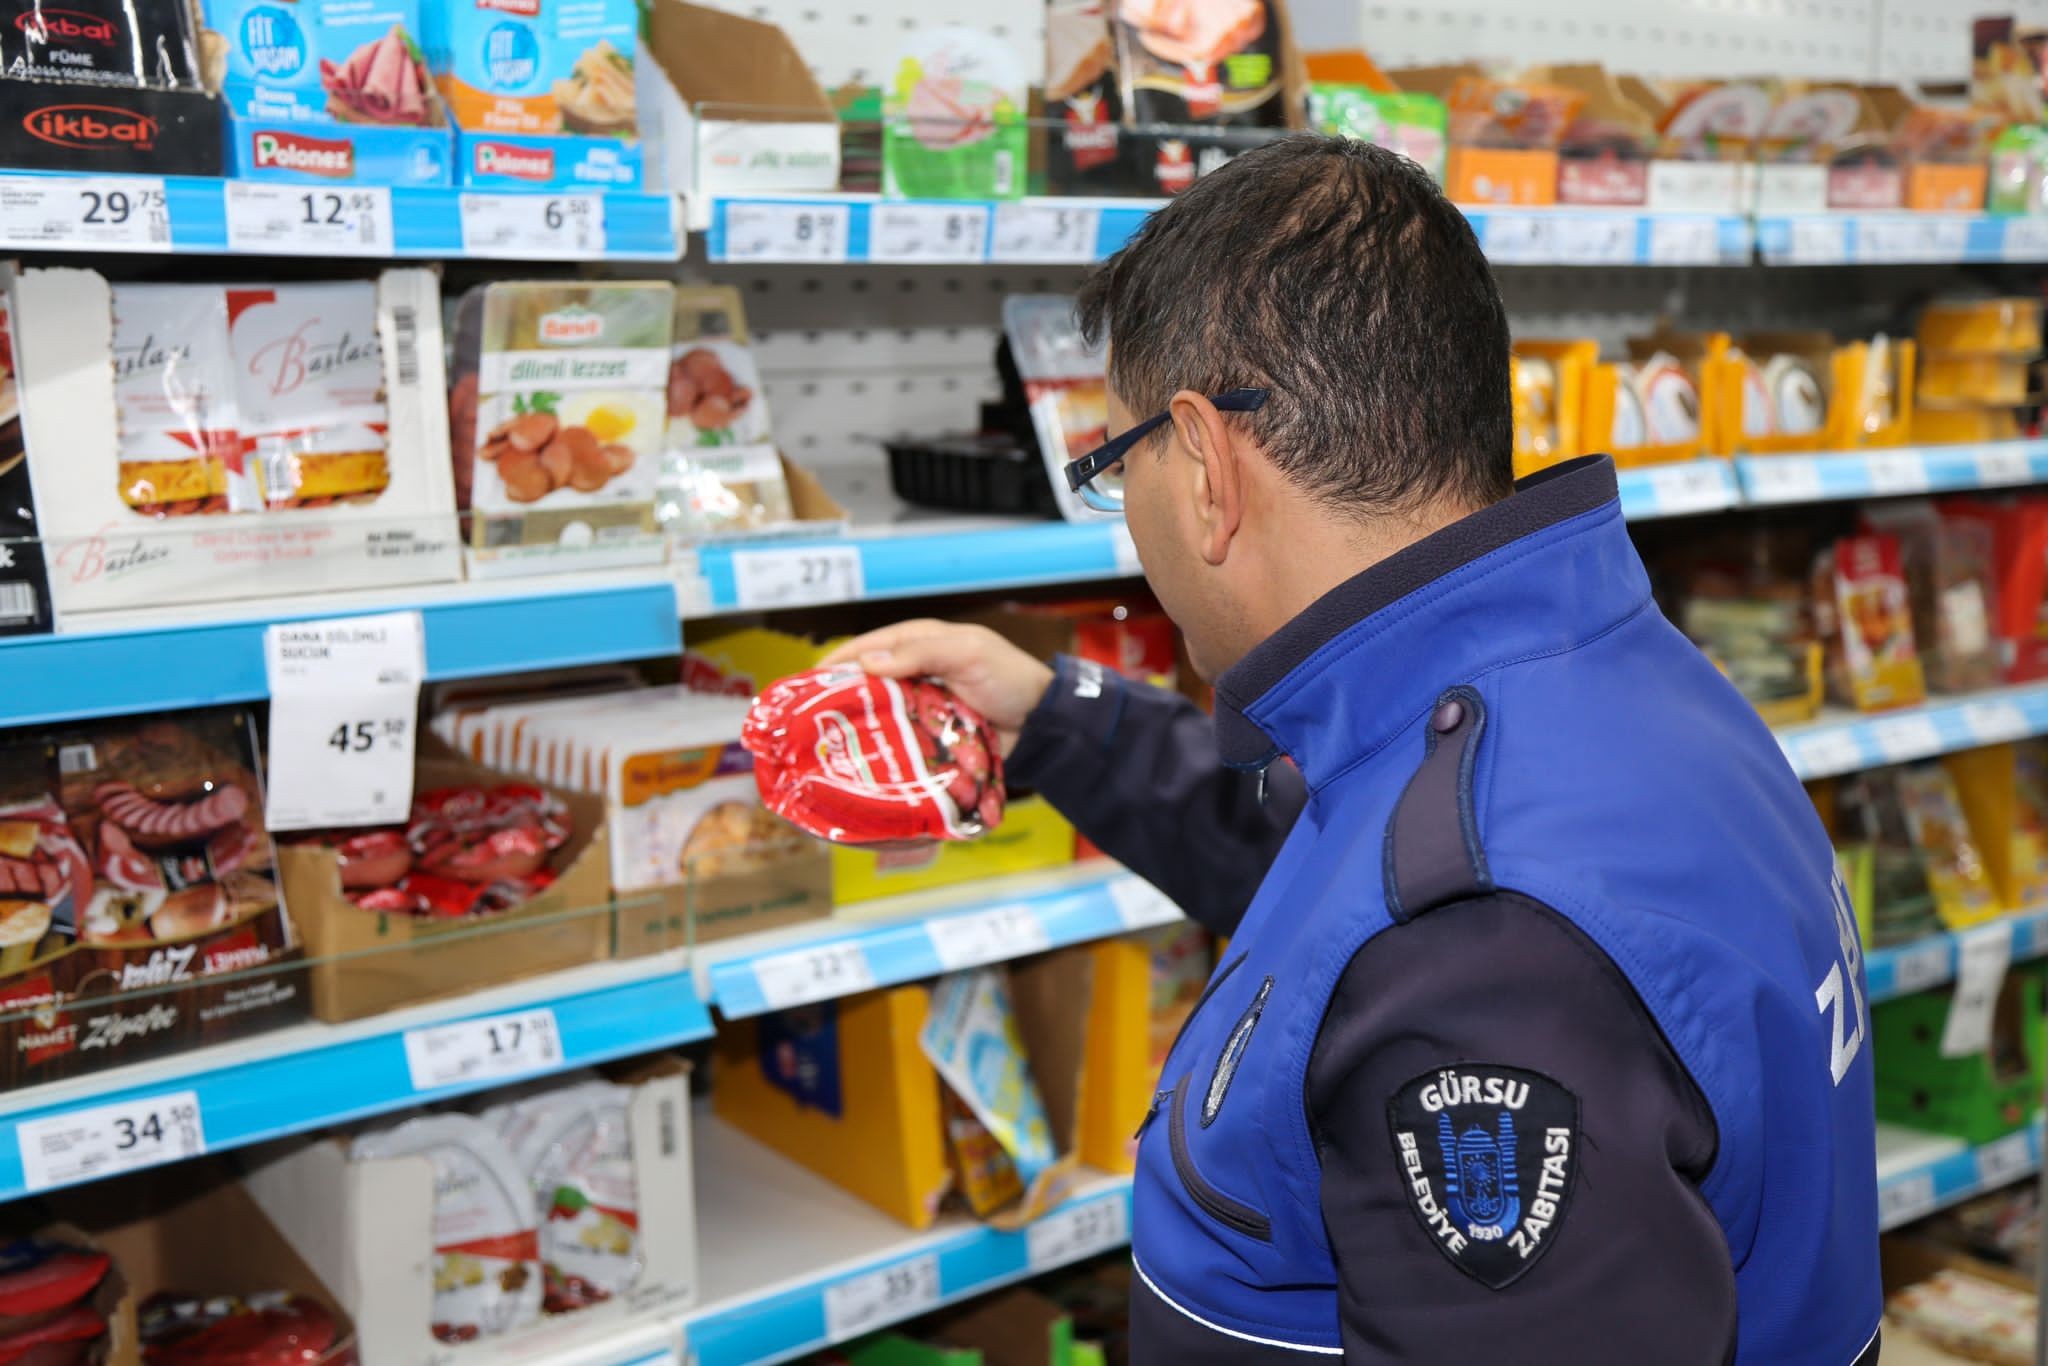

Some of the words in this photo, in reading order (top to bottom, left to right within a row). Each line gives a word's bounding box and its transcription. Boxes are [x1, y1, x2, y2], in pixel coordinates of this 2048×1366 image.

[49, 49, 93, 66] FÜME
[41, 113, 149, 141] ikbal
[256, 134, 348, 169] Polonez
[17, 1024, 79, 1051] NAMET
[1418, 1070, 1531, 1113] GÜRSU
[1396, 1131, 1469, 1257] BELEDİYE
[1506, 1127, 1571, 1260] ZABITASI
[1467, 1223, 1504, 1242] 1930
